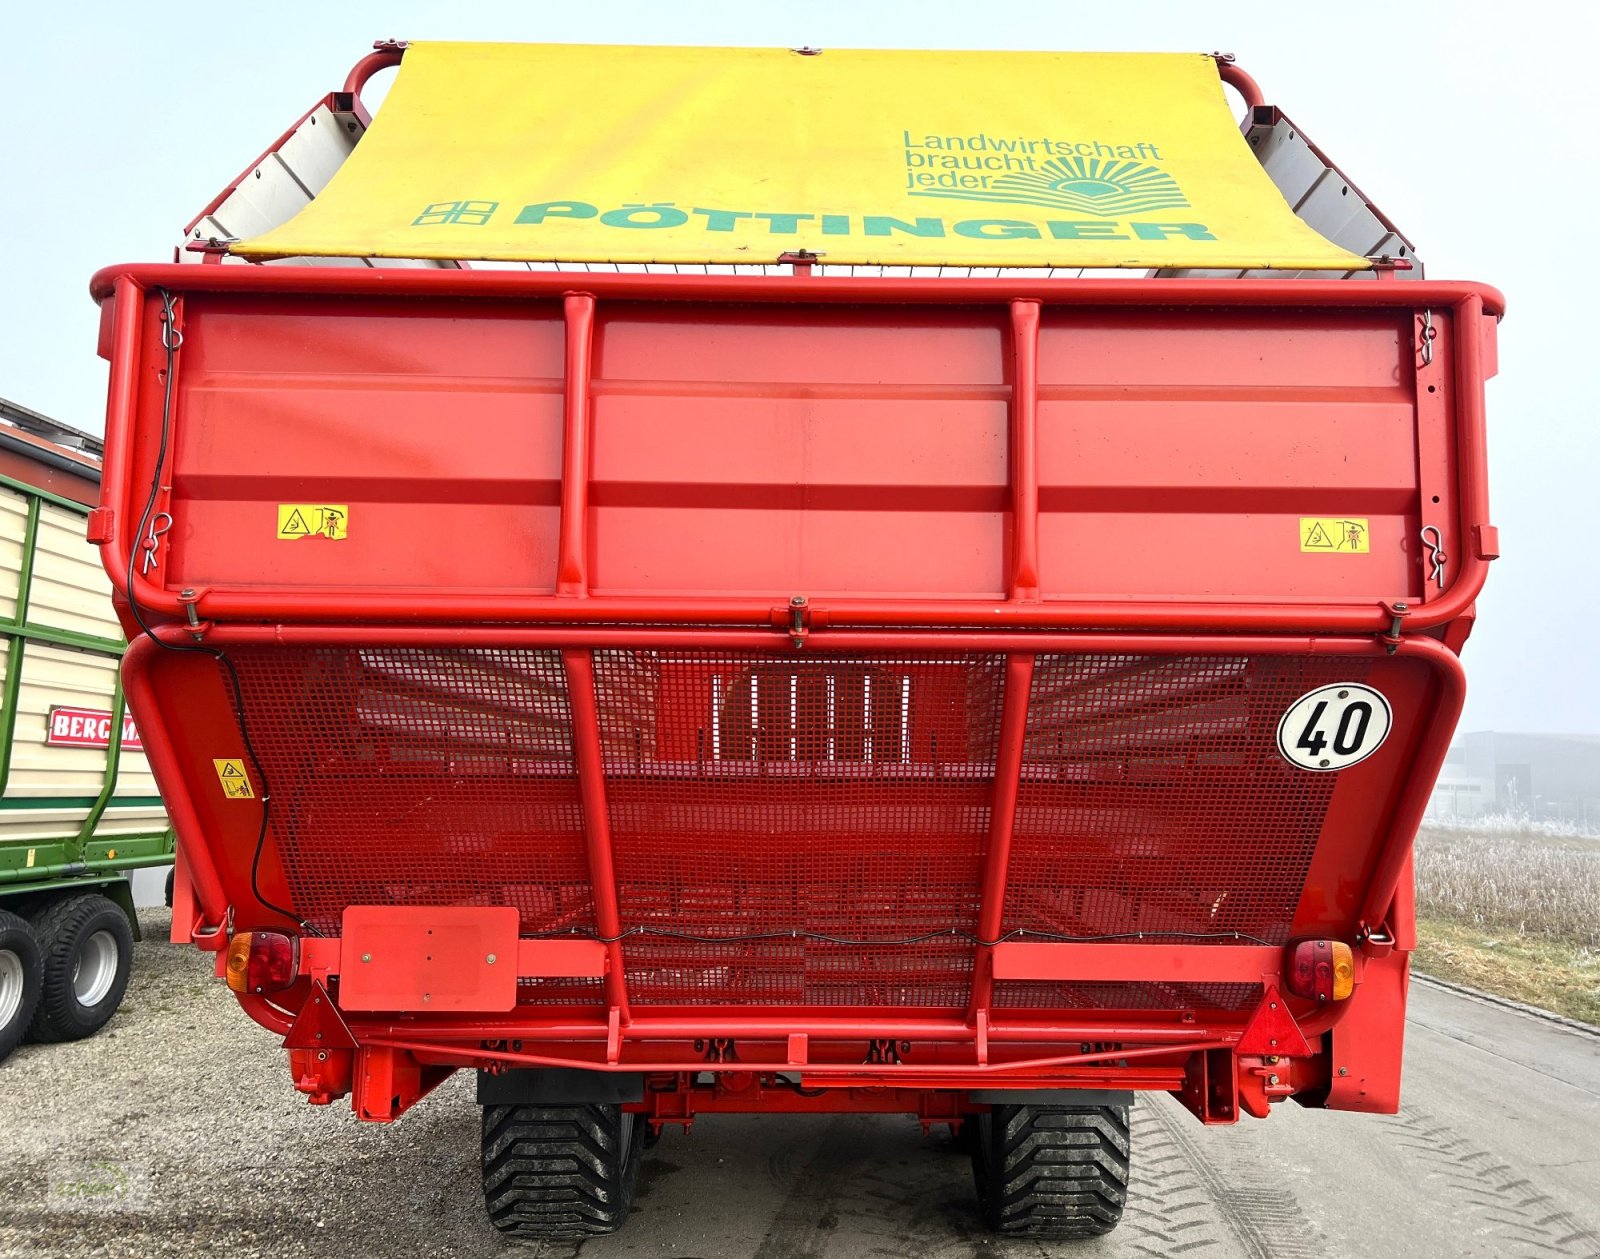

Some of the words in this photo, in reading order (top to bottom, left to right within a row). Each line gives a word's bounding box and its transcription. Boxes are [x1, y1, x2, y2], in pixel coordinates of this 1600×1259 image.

[903, 130, 1163, 161] Landwirtschaft
[904, 150, 1040, 172] braucht
[905, 168, 993, 189] jeder
[513, 200, 1218, 241] PÖTTINGER
[53, 715, 143, 741] BERGM
[1296, 701, 1373, 756] 40
